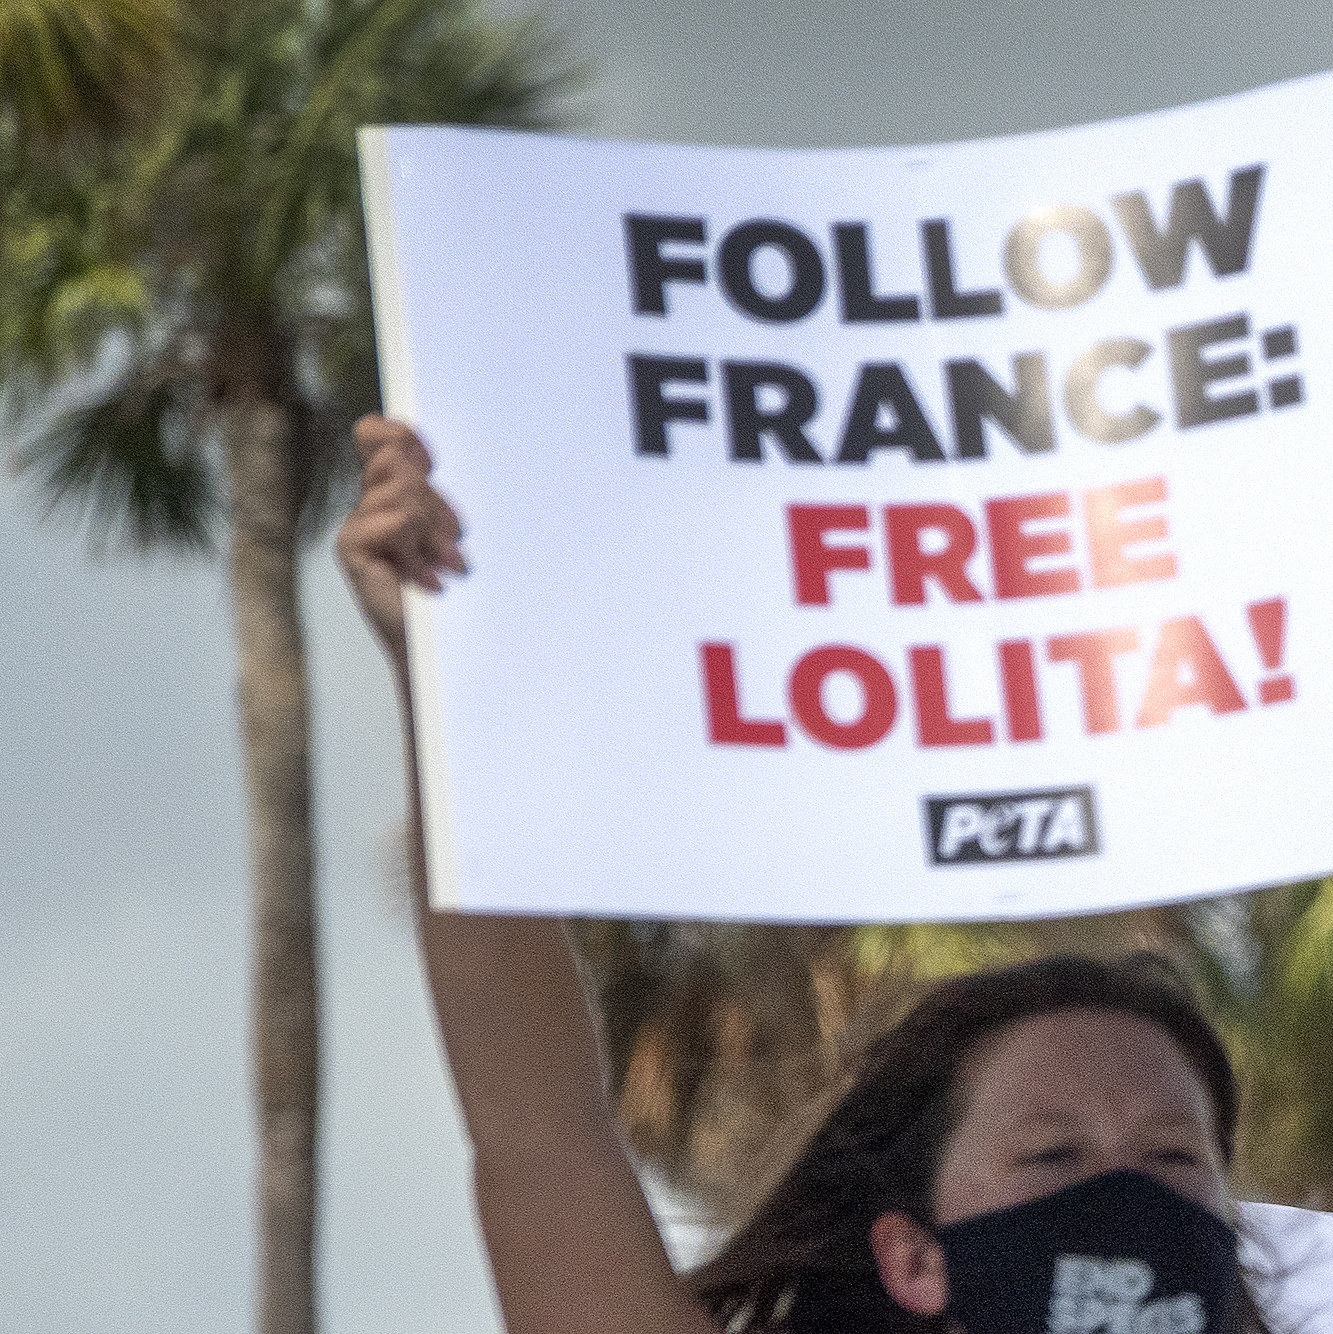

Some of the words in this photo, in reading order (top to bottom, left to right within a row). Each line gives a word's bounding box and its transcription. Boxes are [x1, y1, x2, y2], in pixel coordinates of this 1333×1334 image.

[622, 162, 1268, 324] FOLLOW
[625, 312, 1306, 464] FRANCE:
[785, 476, 1179, 607] FREE
[698, 597, 1298, 750] LOLITA!
